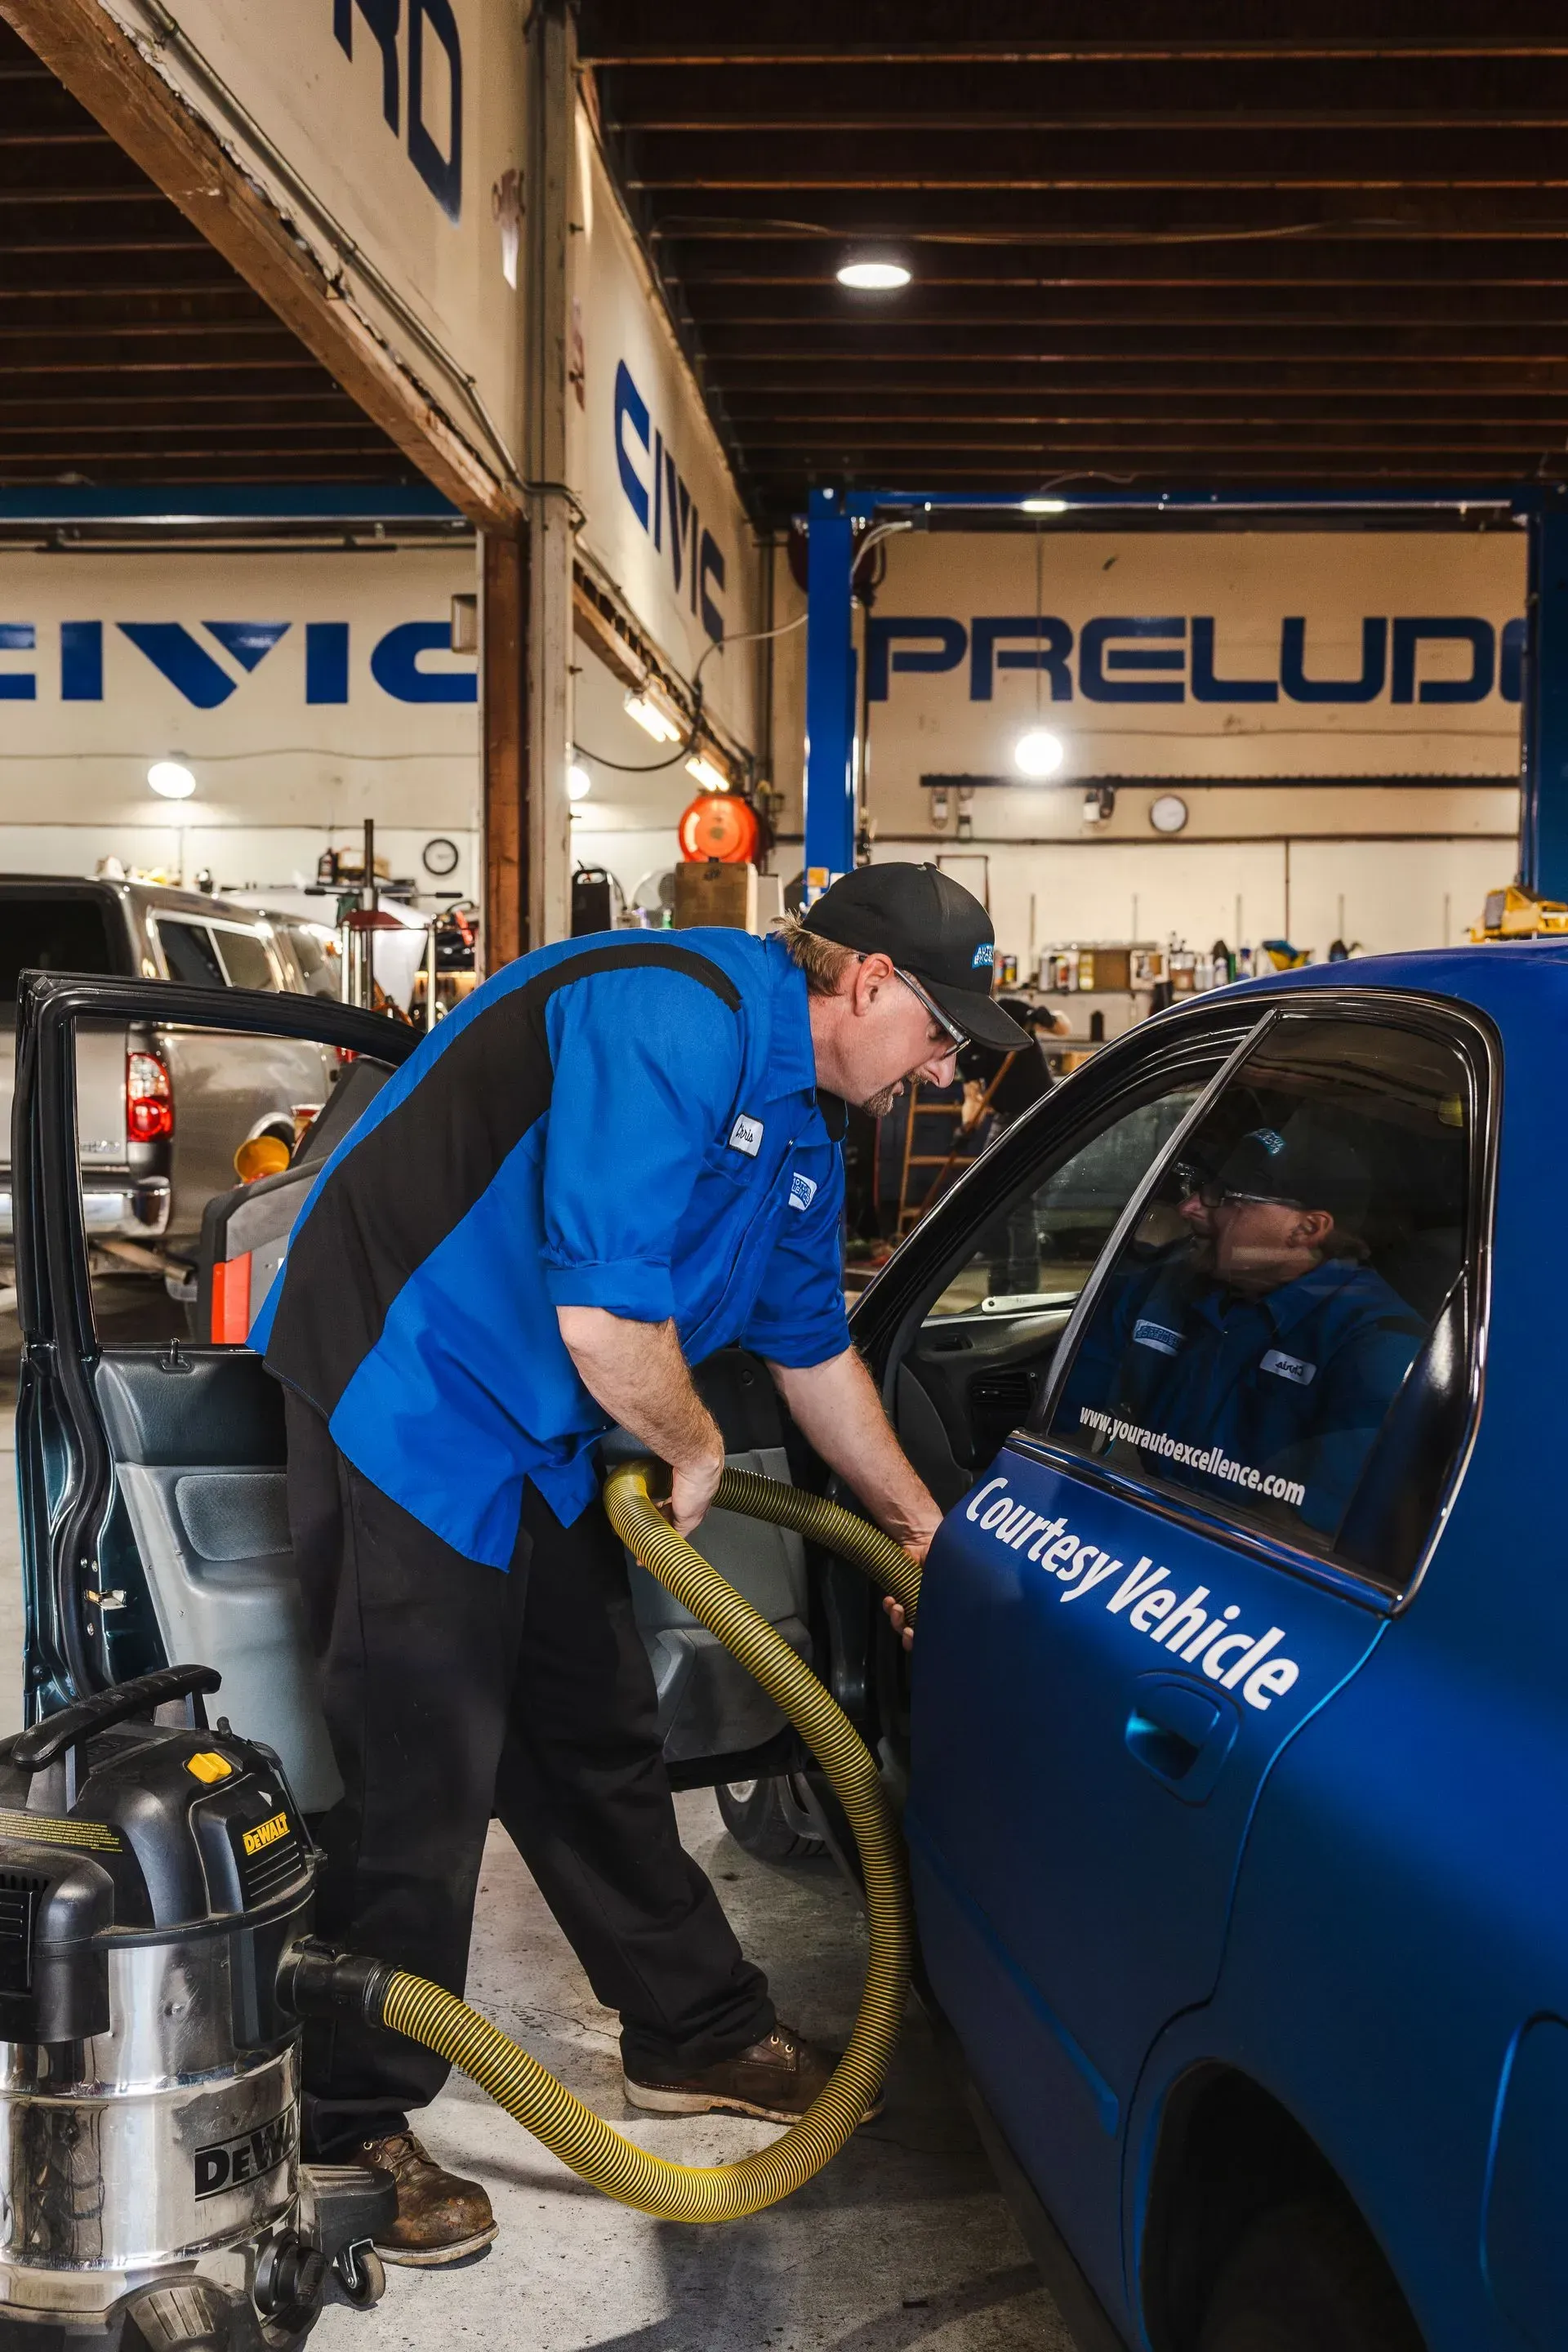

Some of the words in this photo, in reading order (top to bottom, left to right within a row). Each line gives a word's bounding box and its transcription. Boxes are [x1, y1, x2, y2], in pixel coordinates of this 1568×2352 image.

[615, 359, 725, 658] CIVIC
[867, 617, 1526, 703] PRELUD
[1080, 1406, 1305, 1506] www.yourautoexcellence.com
[966, 1477, 1123, 1602] Courtesy
[1106, 1556, 1299, 1711] Vehicle
